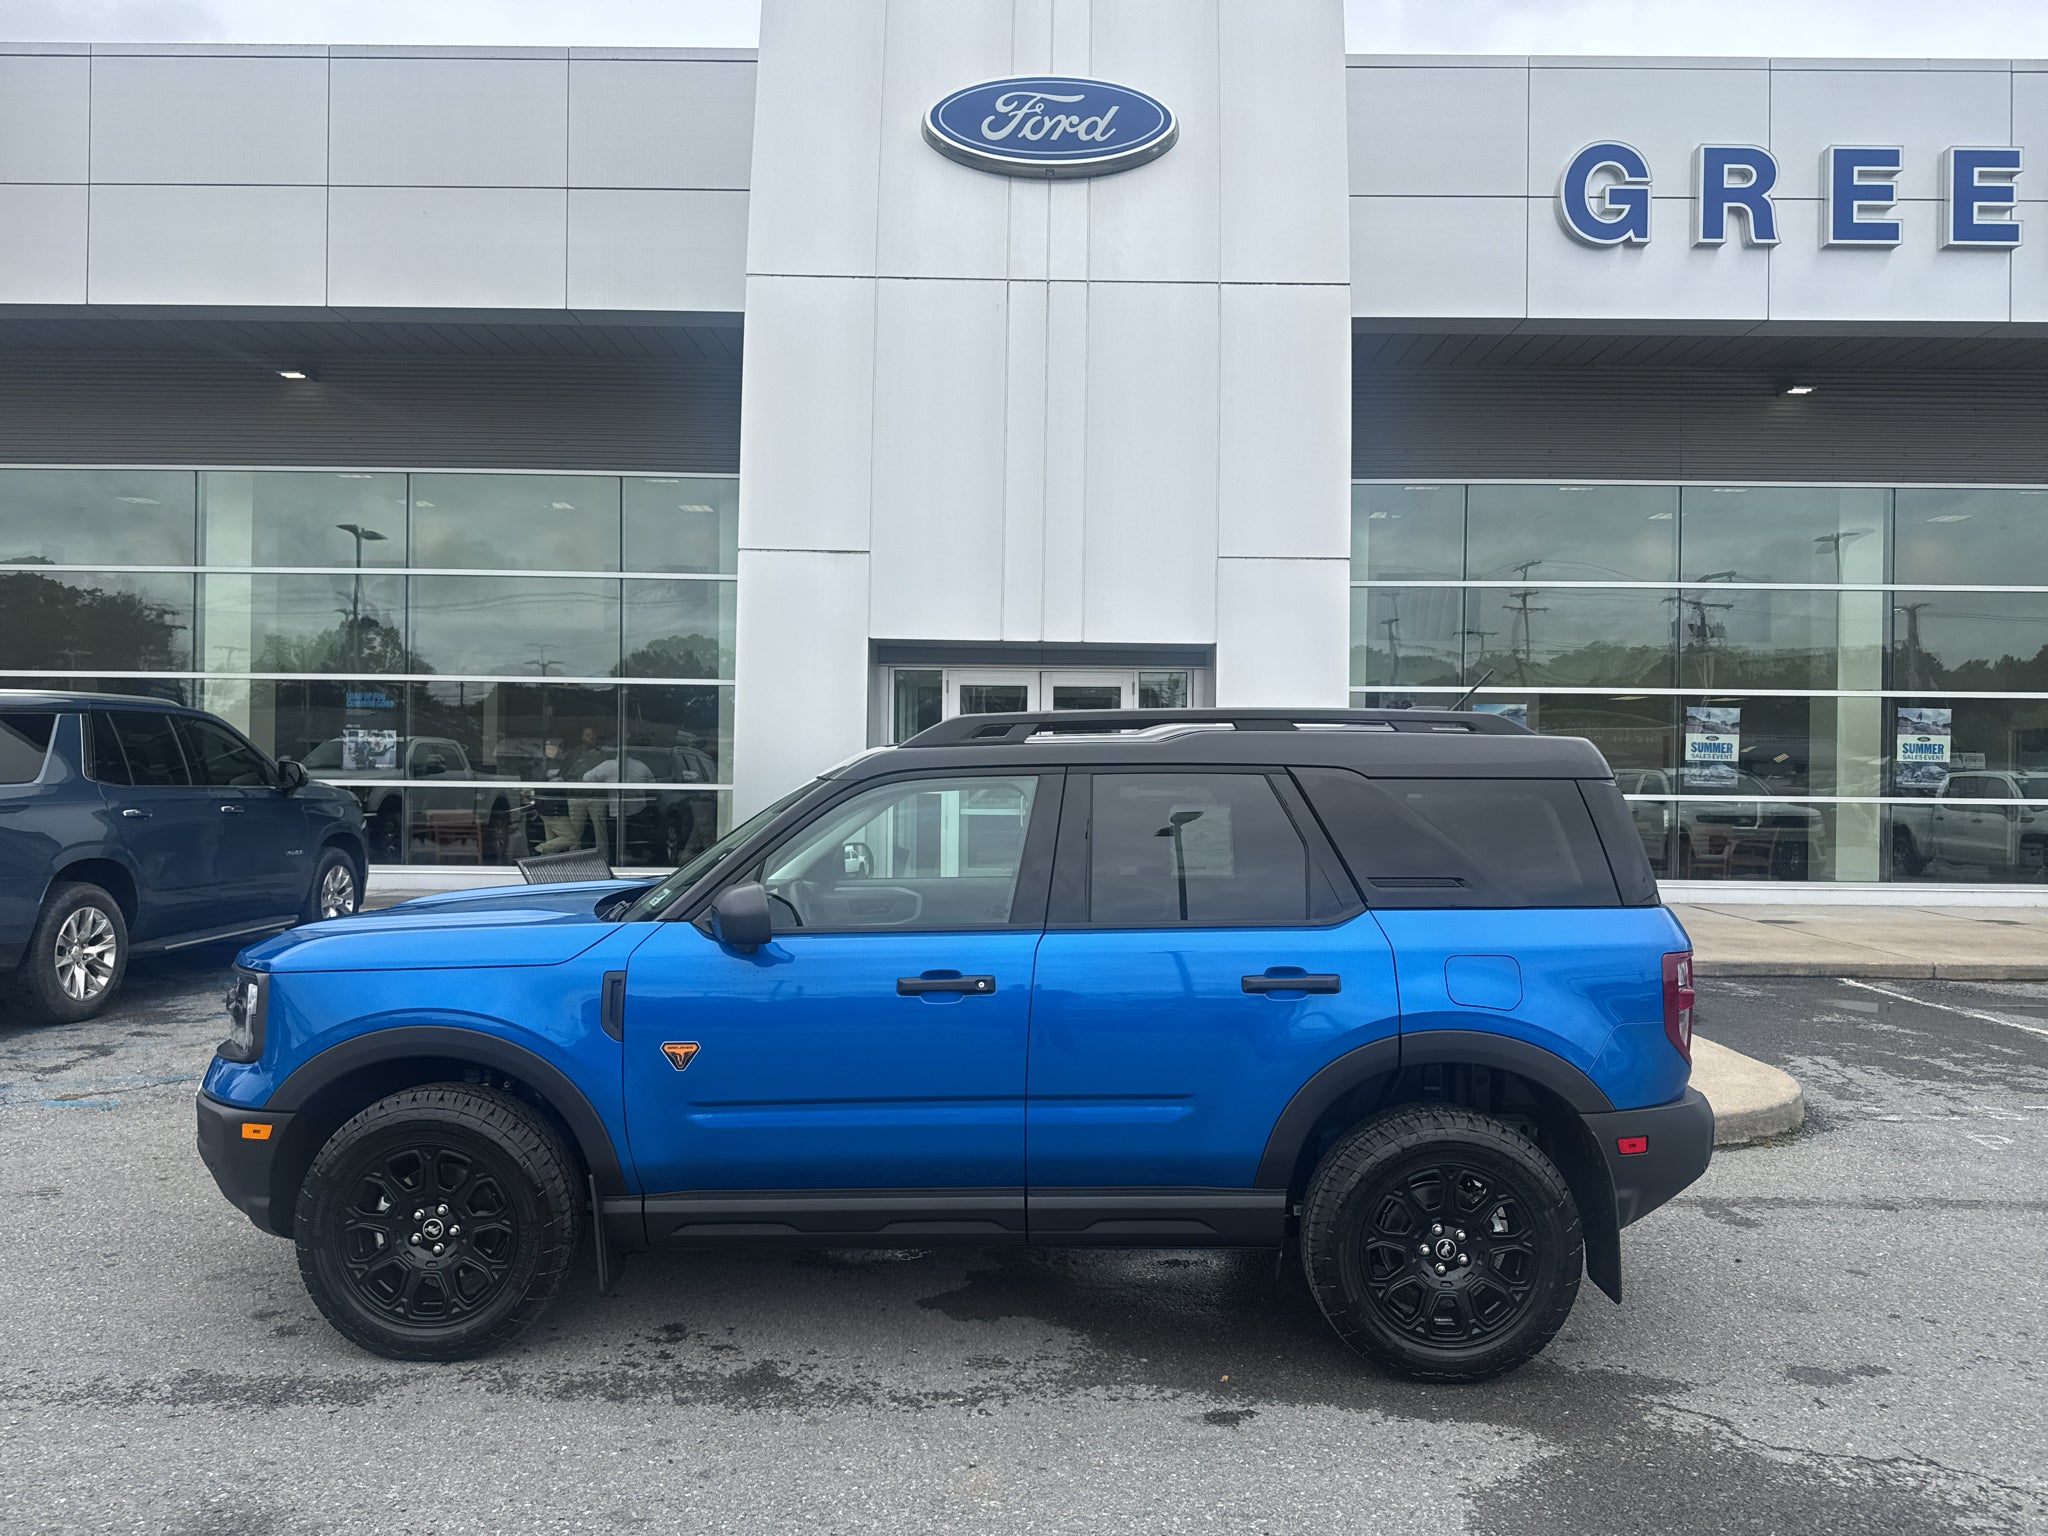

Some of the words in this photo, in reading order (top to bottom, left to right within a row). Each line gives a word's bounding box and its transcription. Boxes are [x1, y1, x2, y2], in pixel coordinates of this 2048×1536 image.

[981, 91, 1119, 141] Ford
[1556, 140, 2024, 249] GREE
[1690, 742, 1733, 754] SUMMER
[1902, 743, 1944, 755] SUMMER
